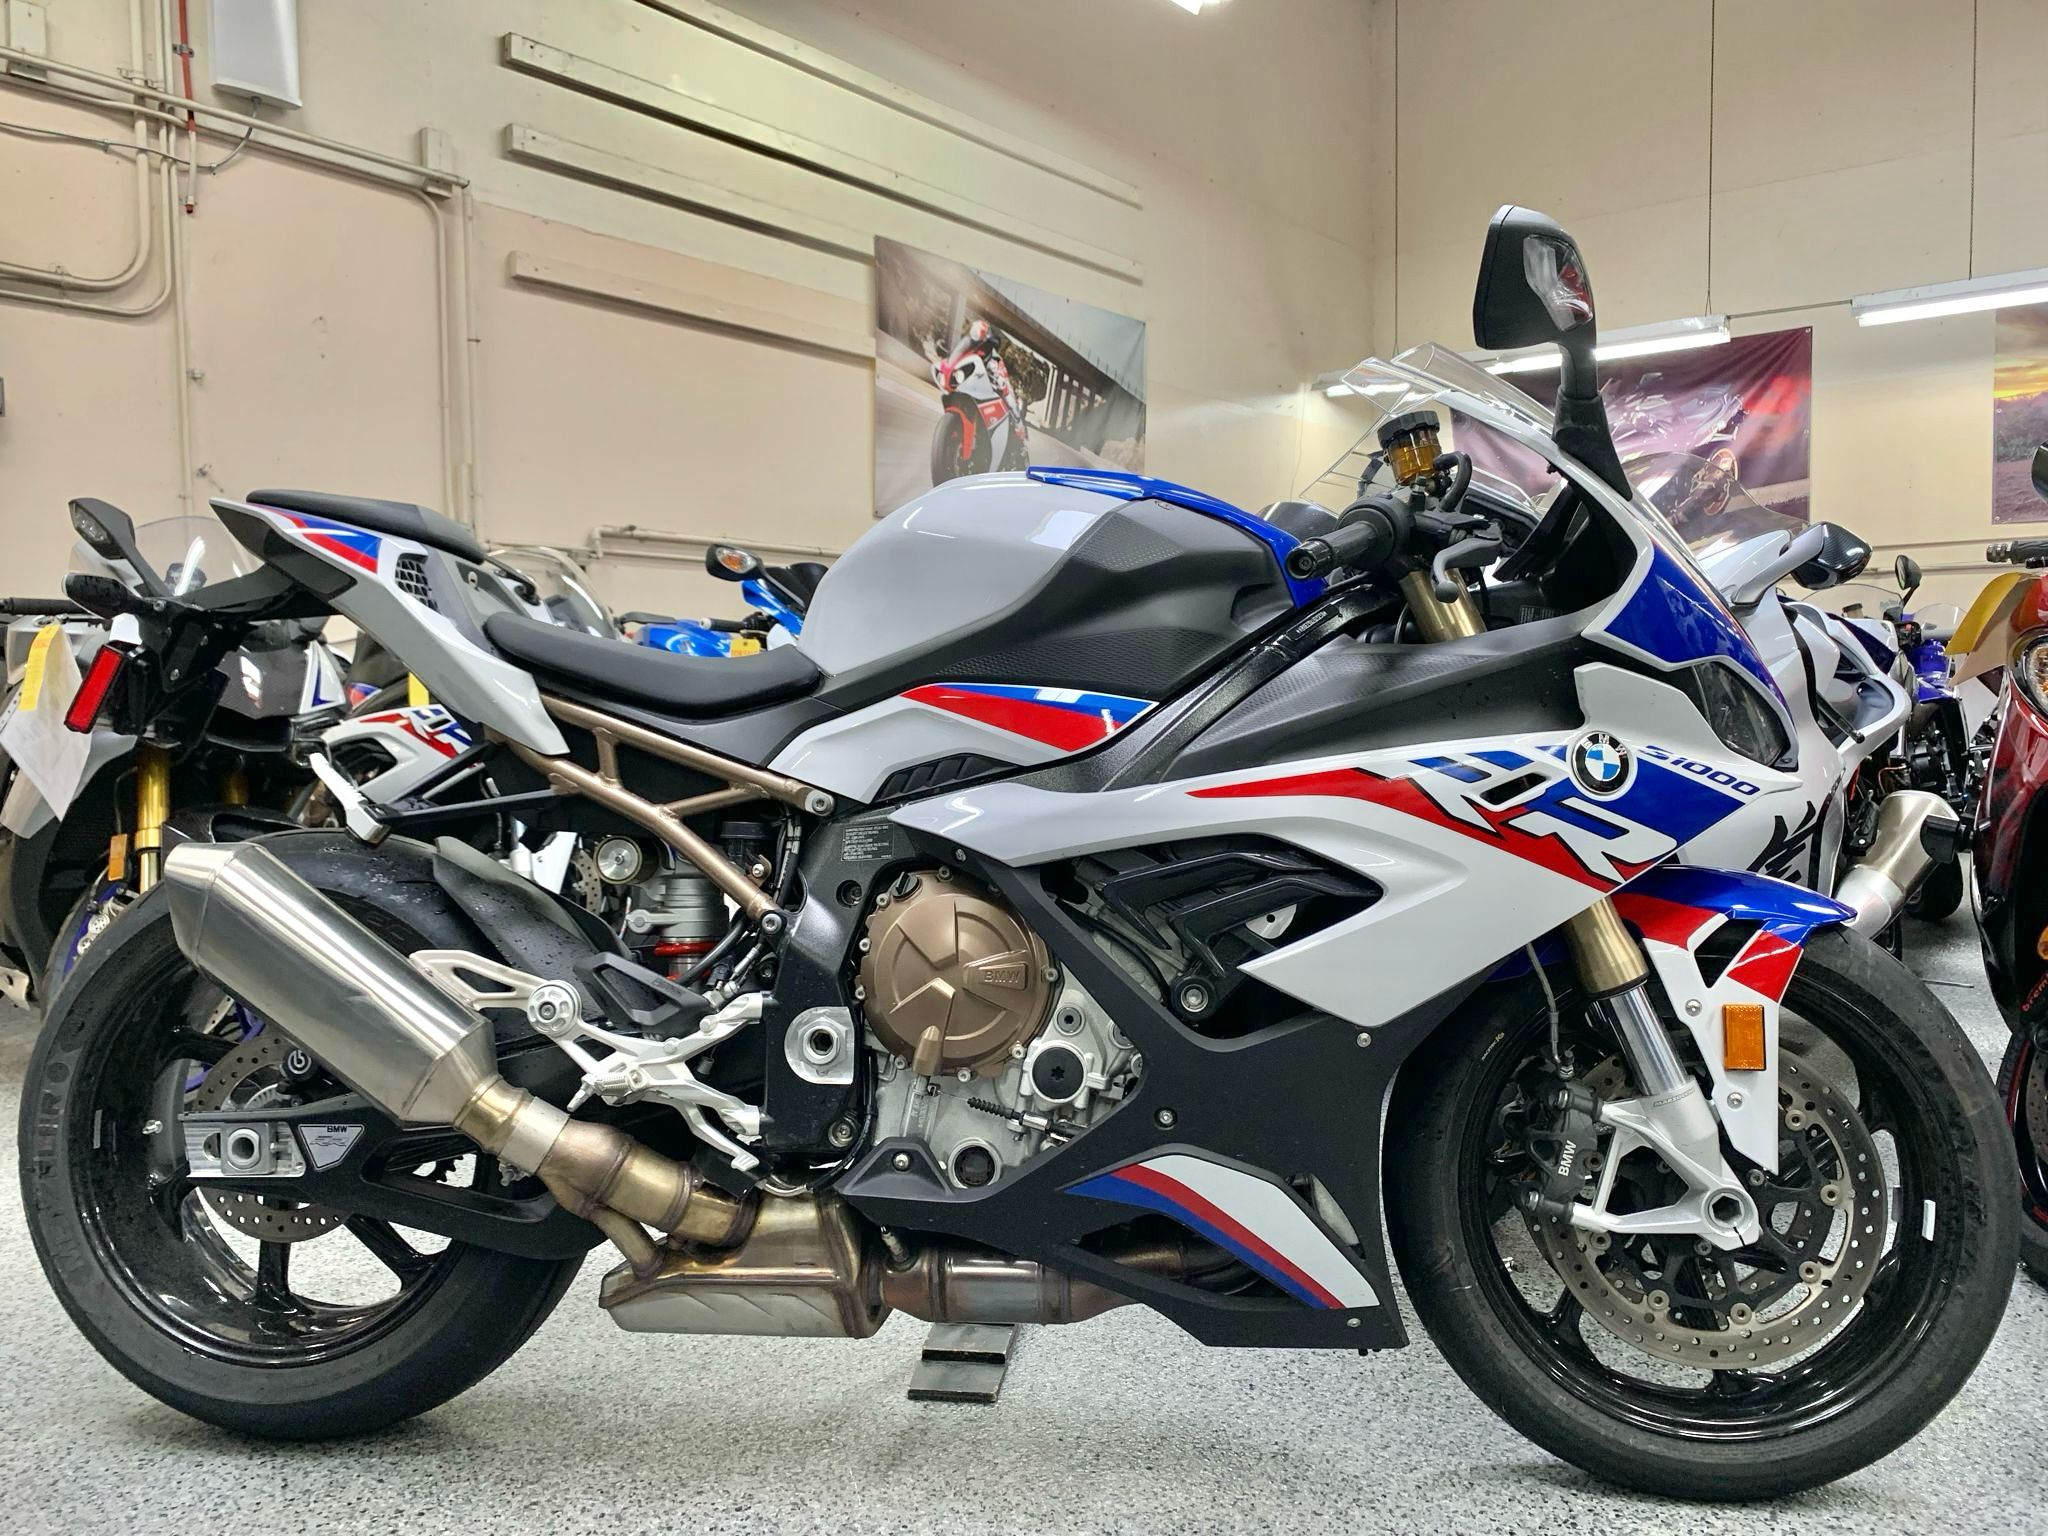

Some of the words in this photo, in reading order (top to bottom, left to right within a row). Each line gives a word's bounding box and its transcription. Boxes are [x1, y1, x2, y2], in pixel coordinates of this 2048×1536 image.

[1580, 733, 1627, 757] BMW
[984, 969, 1020, 983] BMW
[327, 1125, 348, 1133] BMW
[1557, 1139, 1577, 1177] BMW
